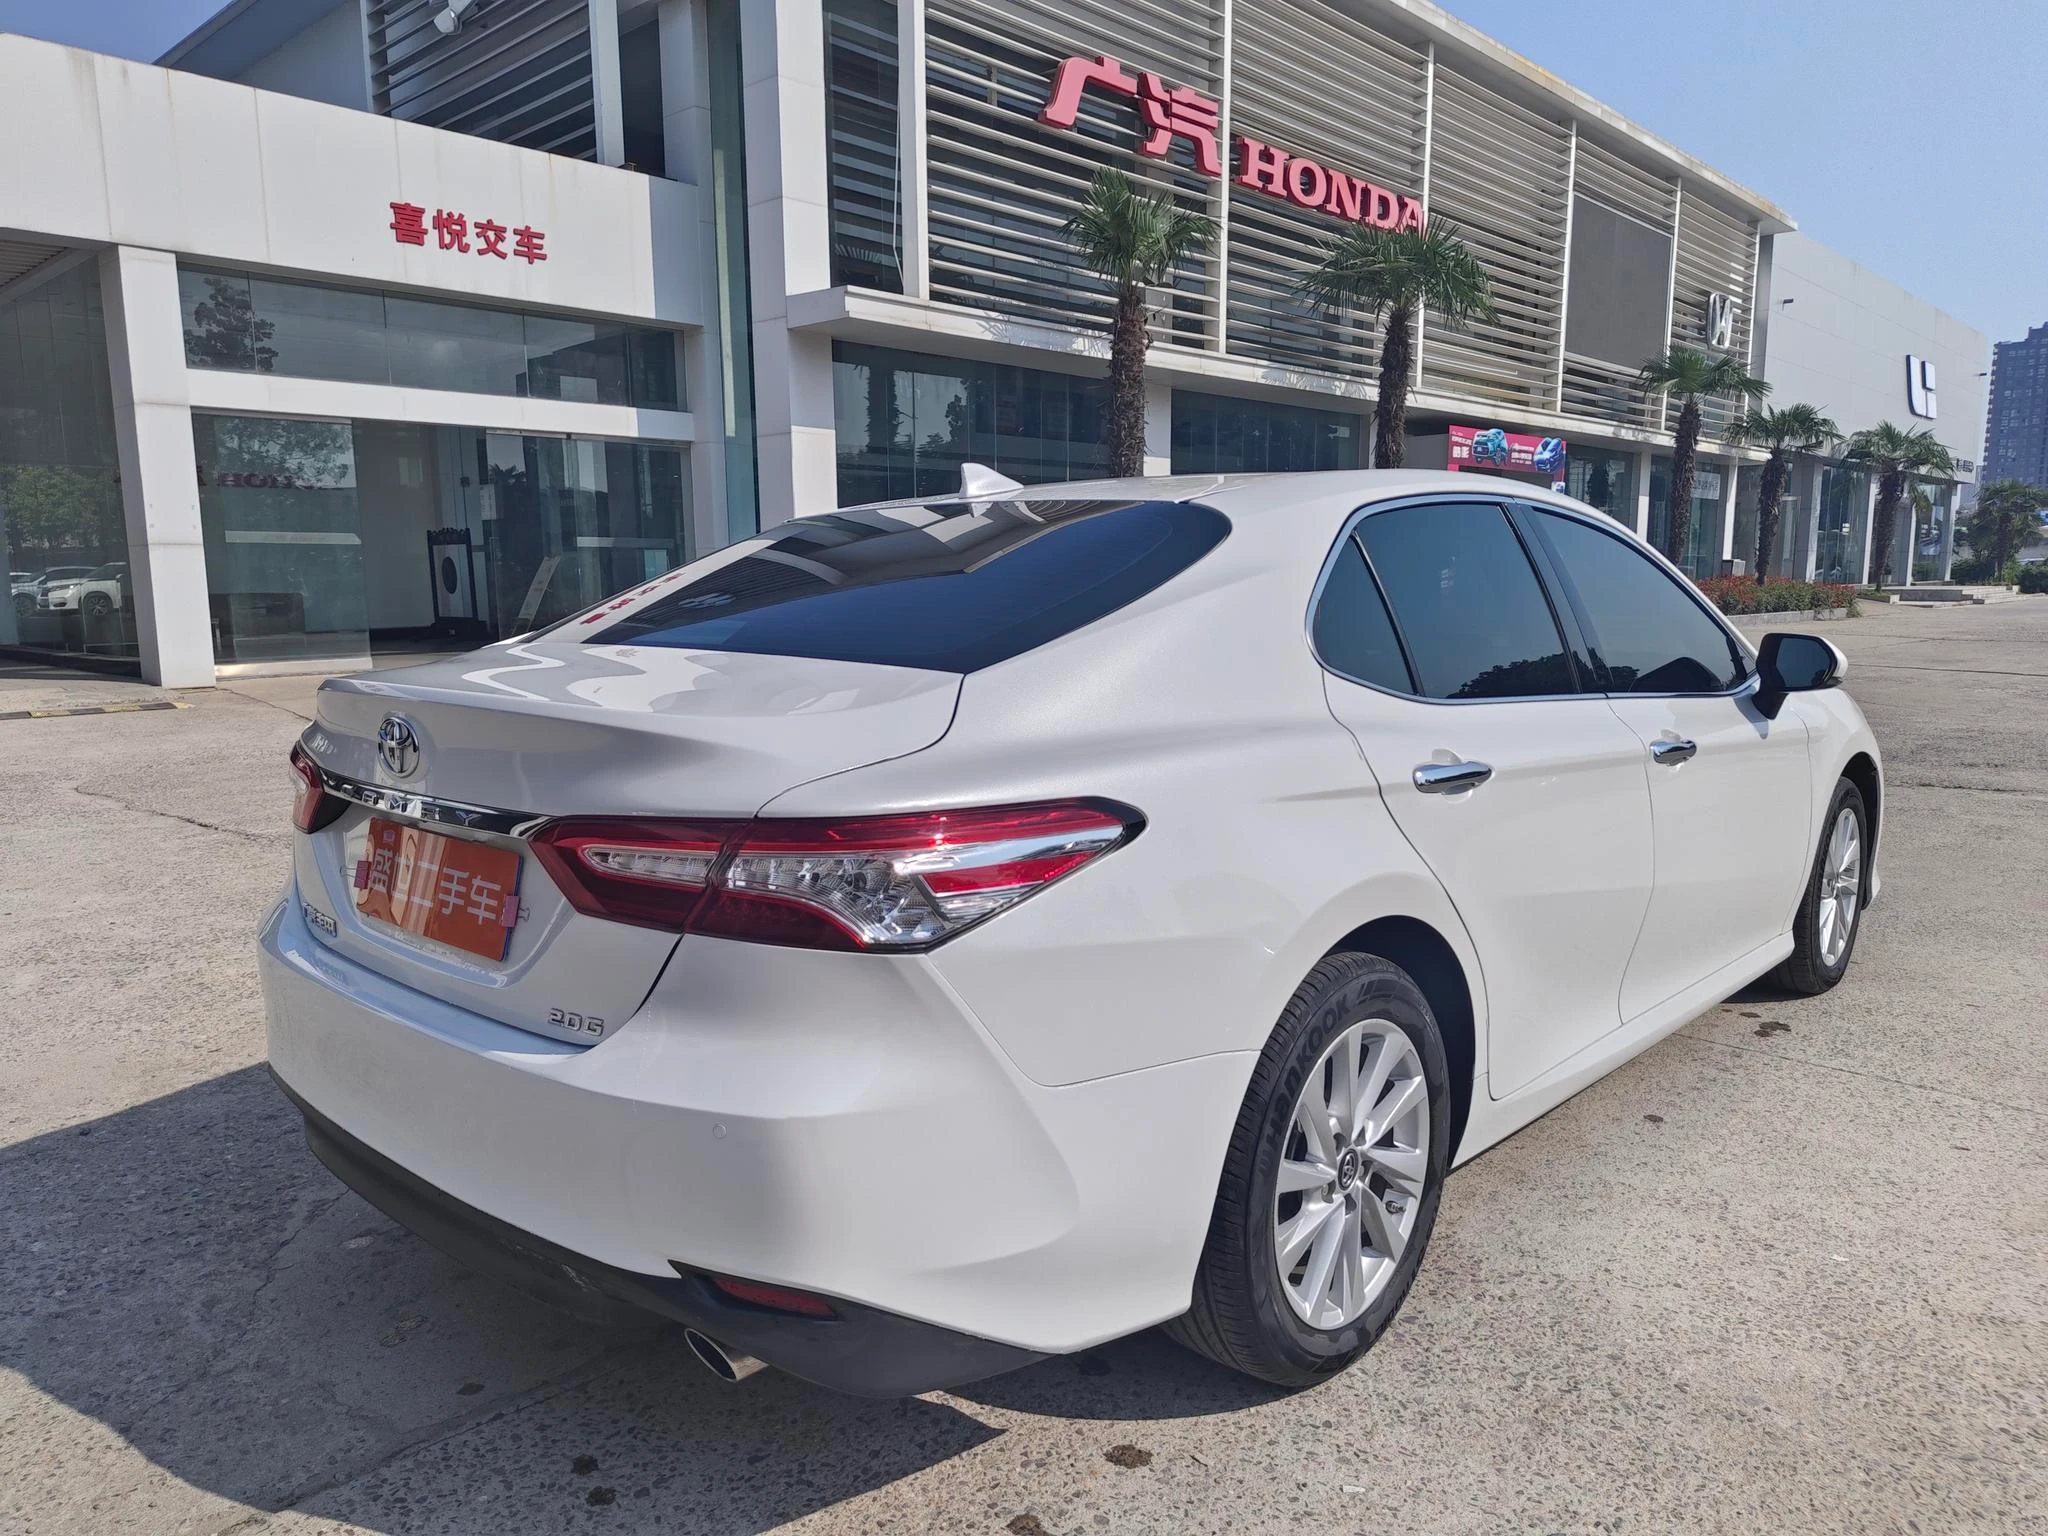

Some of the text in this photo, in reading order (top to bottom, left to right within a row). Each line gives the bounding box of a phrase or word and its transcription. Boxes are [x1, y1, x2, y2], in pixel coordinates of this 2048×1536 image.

[1038, 55, 1428, 234] 广汽 HONDA
[389, 202, 548, 265] 喜悦交车
